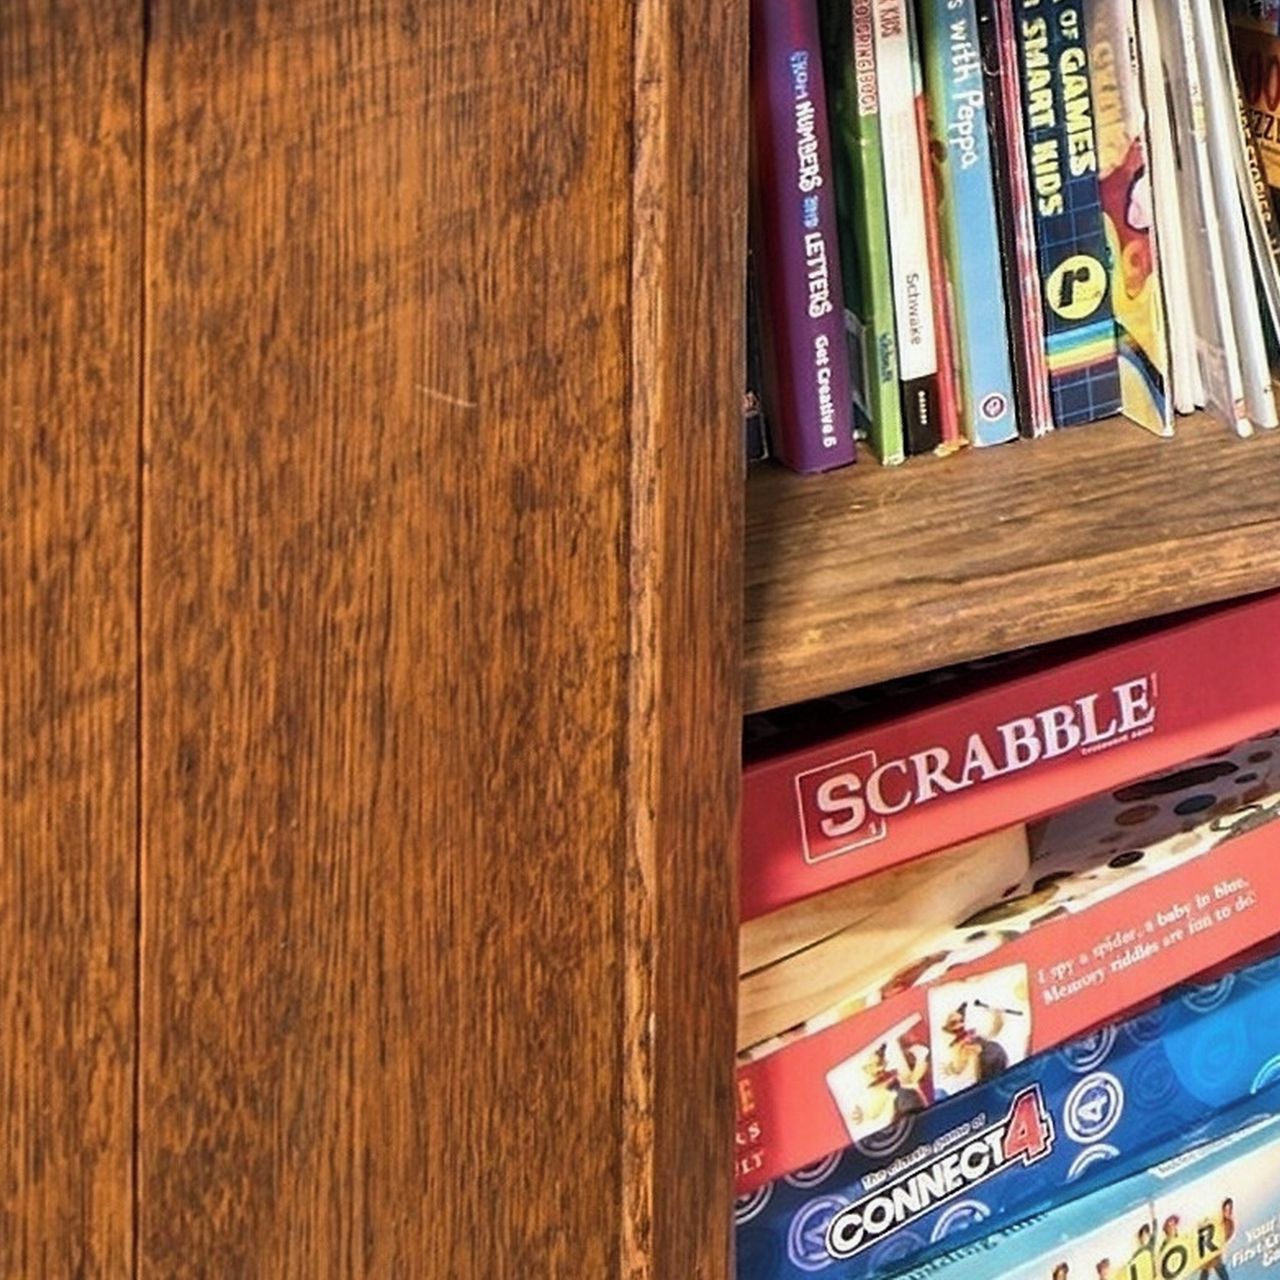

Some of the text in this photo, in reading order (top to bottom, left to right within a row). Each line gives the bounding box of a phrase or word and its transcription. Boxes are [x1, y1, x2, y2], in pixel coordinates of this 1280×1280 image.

[881, 6, 902, 38] KIDS
[951, 20, 978, 83] with
[1059, 9, 1078, 41] OF
[1023, 20, 1054, 155] SMART
[1060, 47, 1098, 177] GAMES
[794, 101, 820, 193] NUMBERS
[945, 90, 985, 169] Peppa
[1031, 161, 1064, 218] KIDS
[805, 232, 831, 320] LETTERS
[904, 273, 923, 345] Schwake
[815, 335, 829, 362] Get
[817, 363, 834, 431] Creative
[815, 676, 1157, 839] SCRABBLE
[1042, 903, 1232, 1005] Memory riddles are fun to
[1050, 958, 1075, 981] spy
[1156, 903, 1193, 928] baby
[1194, 893, 1211, 909] in
[828, 1124, 1007, 1256] CONNECT
[1002, 1086, 1050, 1164] 4
[1230, 1243, 1263, 1269] First
[1244, 1219, 1276, 1242] Your
